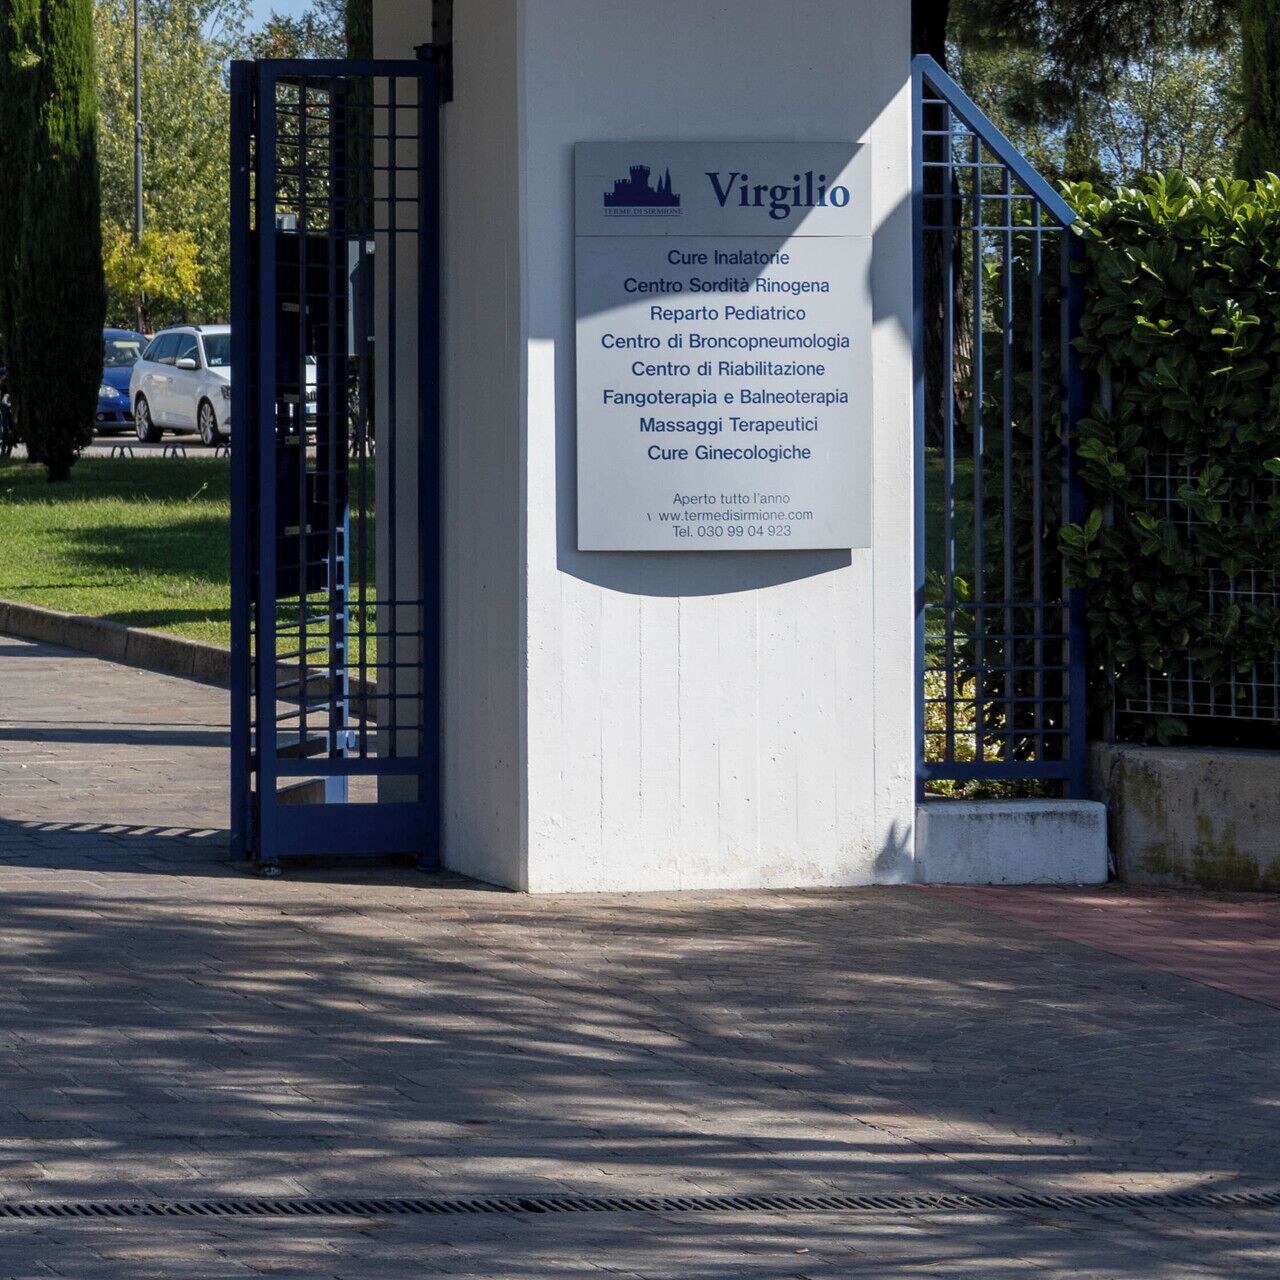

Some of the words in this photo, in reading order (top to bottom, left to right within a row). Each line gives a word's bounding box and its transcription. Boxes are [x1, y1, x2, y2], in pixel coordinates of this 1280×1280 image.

[705, 170, 850, 220] Virgilio
[667, 249, 708, 265] Cure
[714, 249, 790, 265] Inalatorie
[623, 277, 683, 293] Centro
[689, 276, 750, 293] Sordità
[755, 277, 830, 296] Rinogena
[650, 306, 719, 324] Reparto
[725, 305, 806, 321] Pediatrico
[601, 333, 661, 349] Centro
[667, 333, 683, 349] di
[689, 333, 850, 352] Broncopneumologia
[631, 361, 691, 377] Centro
[697, 361, 712, 377] di
[718, 360, 826, 377] Riabilitazione
[603, 389, 718, 408] Fangoterapia
[724, 393, 735, 405] e
[740, 389, 849, 407] Balneoterapia
[640, 417, 723, 436] Massaggi
[729, 416, 818, 434] Terapeutici
[647, 445, 689, 461] Cure
[695, 445, 812, 464] Ginecologiche
[672, 493, 717, 506] Aperto
[720, 493, 750, 504] tutto
[753, 493, 791, 504] l'anno
[647, 509, 814, 521] ww.termedisirmione.com
[672, 525, 693, 537] Tel.
[697, 525, 724, 537] 030
[727, 525, 744, 537] 99
[747, 525, 764, 537] 04
[767, 525, 792, 536] 923
